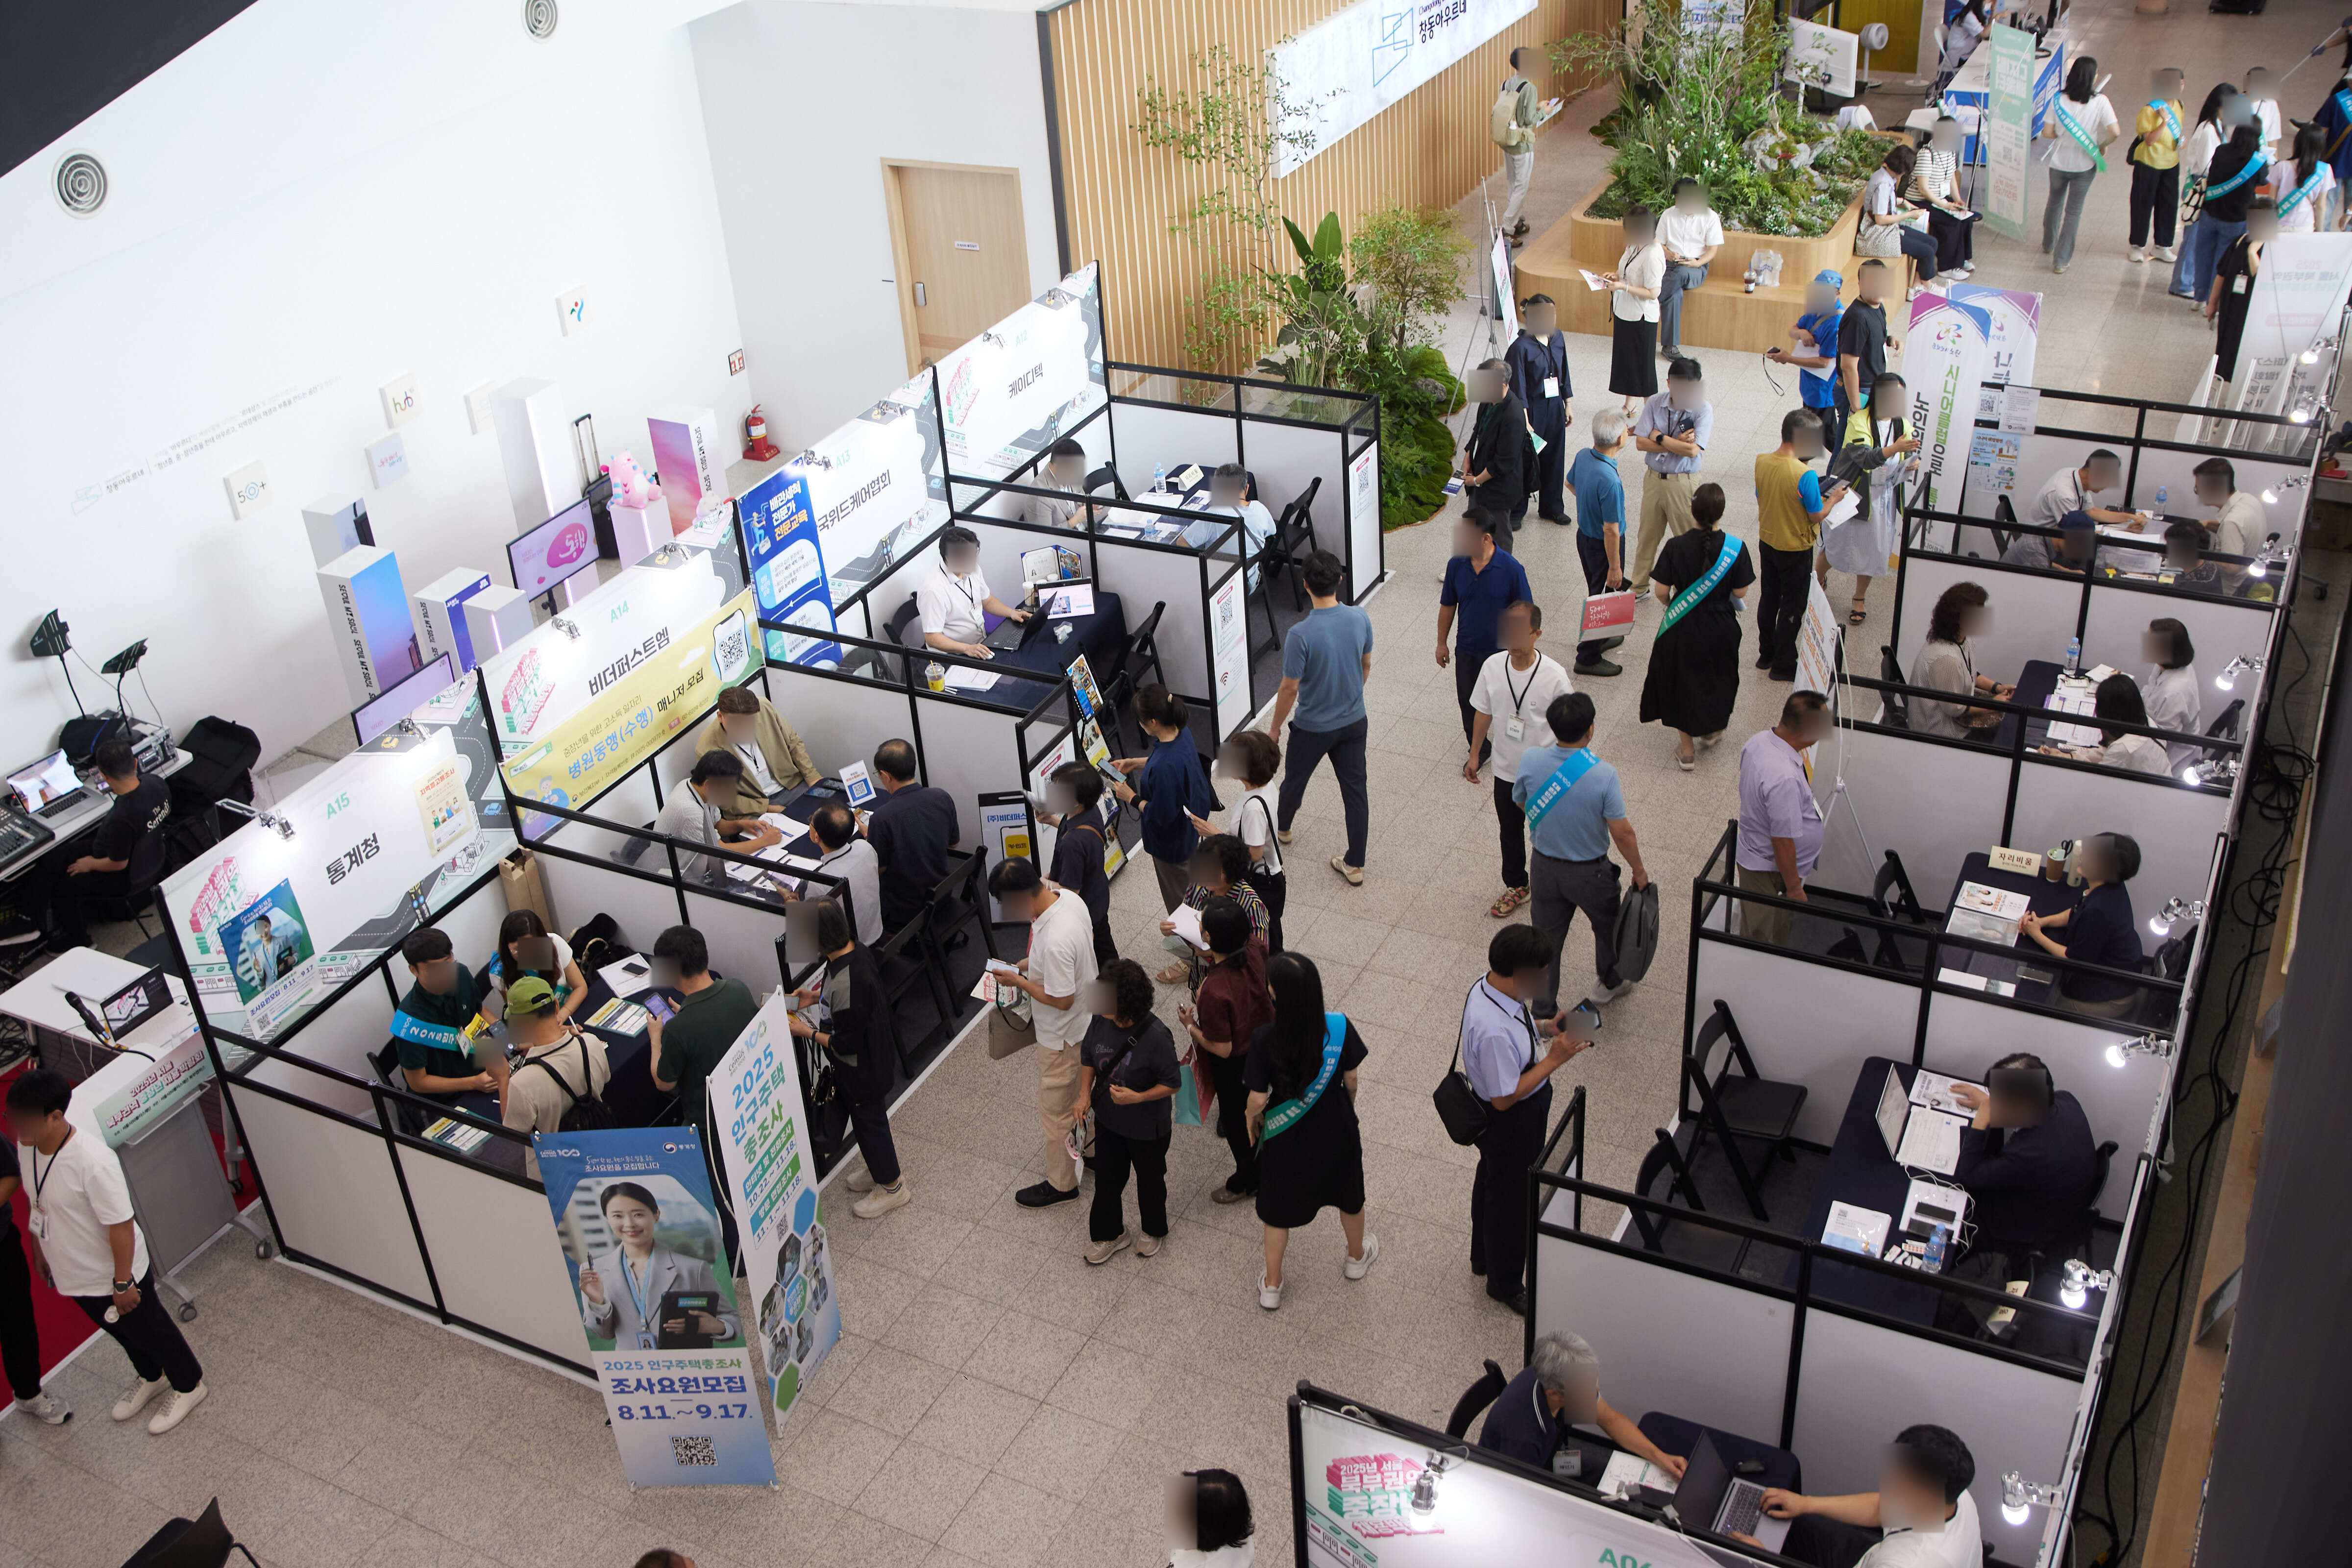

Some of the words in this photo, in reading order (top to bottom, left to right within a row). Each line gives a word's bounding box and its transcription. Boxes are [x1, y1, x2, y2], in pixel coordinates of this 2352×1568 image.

[1420, 0, 1466, 43] 창동아우르네
[1015, 330, 1028, 346] A12
[1008, 362, 1043, 399] 케이디텍
[835, 449, 851, 469] A13
[769, 480, 802, 511] 배관세척
[816, 468, 892, 535] 국위드케어협회
[772, 500, 796, 526] 전문가
[774, 509, 808, 541] 전문교육
[339, 584, 350, 607] SEOUL
[611, 600, 630, 623] A14
[354, 639, 366, 662] SEOUL
[588, 627, 671, 697] 비더퍼스트엠
[564, 733, 589, 758] 중장년을
[589, 722, 602, 738] 위한
[604, 708, 623, 729] 고소득
[623, 694, 642, 712] 일자리
[568, 706, 654, 779] 병원동행(수행)
[657, 684, 685, 712] 매니저
[686, 668, 704, 690] 모집
[579, 780, 600, 797] 보건복지부
[152, 805, 161, 815] The
[325, 792, 350, 820] A15
[325, 833, 381, 886] 통계청
[1998, 852, 2033, 866] 자리비움
[250, 989, 281, 1016] 조사요원모집
[129, 1072, 158, 1097] 2025년
[158, 1060, 174, 1078] 서울
[732, 1043, 774, 1110] 2025
[106, 1099, 141, 1128] 북부권역
[138, 1079, 165, 1104] 중장년
[732, 1061, 785, 1147] 인구주택
[744, 1099, 783, 1165] 총조사
[585, 1163, 621, 1172] 조사요원을
[623, 1162, 660, 1171] 모집합니다
[745, 1163, 762, 1192] 인터넷
[763, 1155, 770, 1169] 및
[770, 1124, 792, 1157] 전화조사
[776, 1140, 796, 1170] 11.18.
[759, 1201, 770, 1219] 방문
[771, 1167, 792, 1201] 면접조사
[782, 1175, 802, 1207] 11.18.
[603, 1360, 644, 1371] 2025
[647, 1358, 742, 1371] 인구주택총조사
[611, 1375, 747, 1395] 조사요원모집
[617, 1403, 753, 1421] 8.11.~9.17.
[1340, 1462, 1377, 1475] 2025년
[1380, 1460, 1403, 1471] 서울
